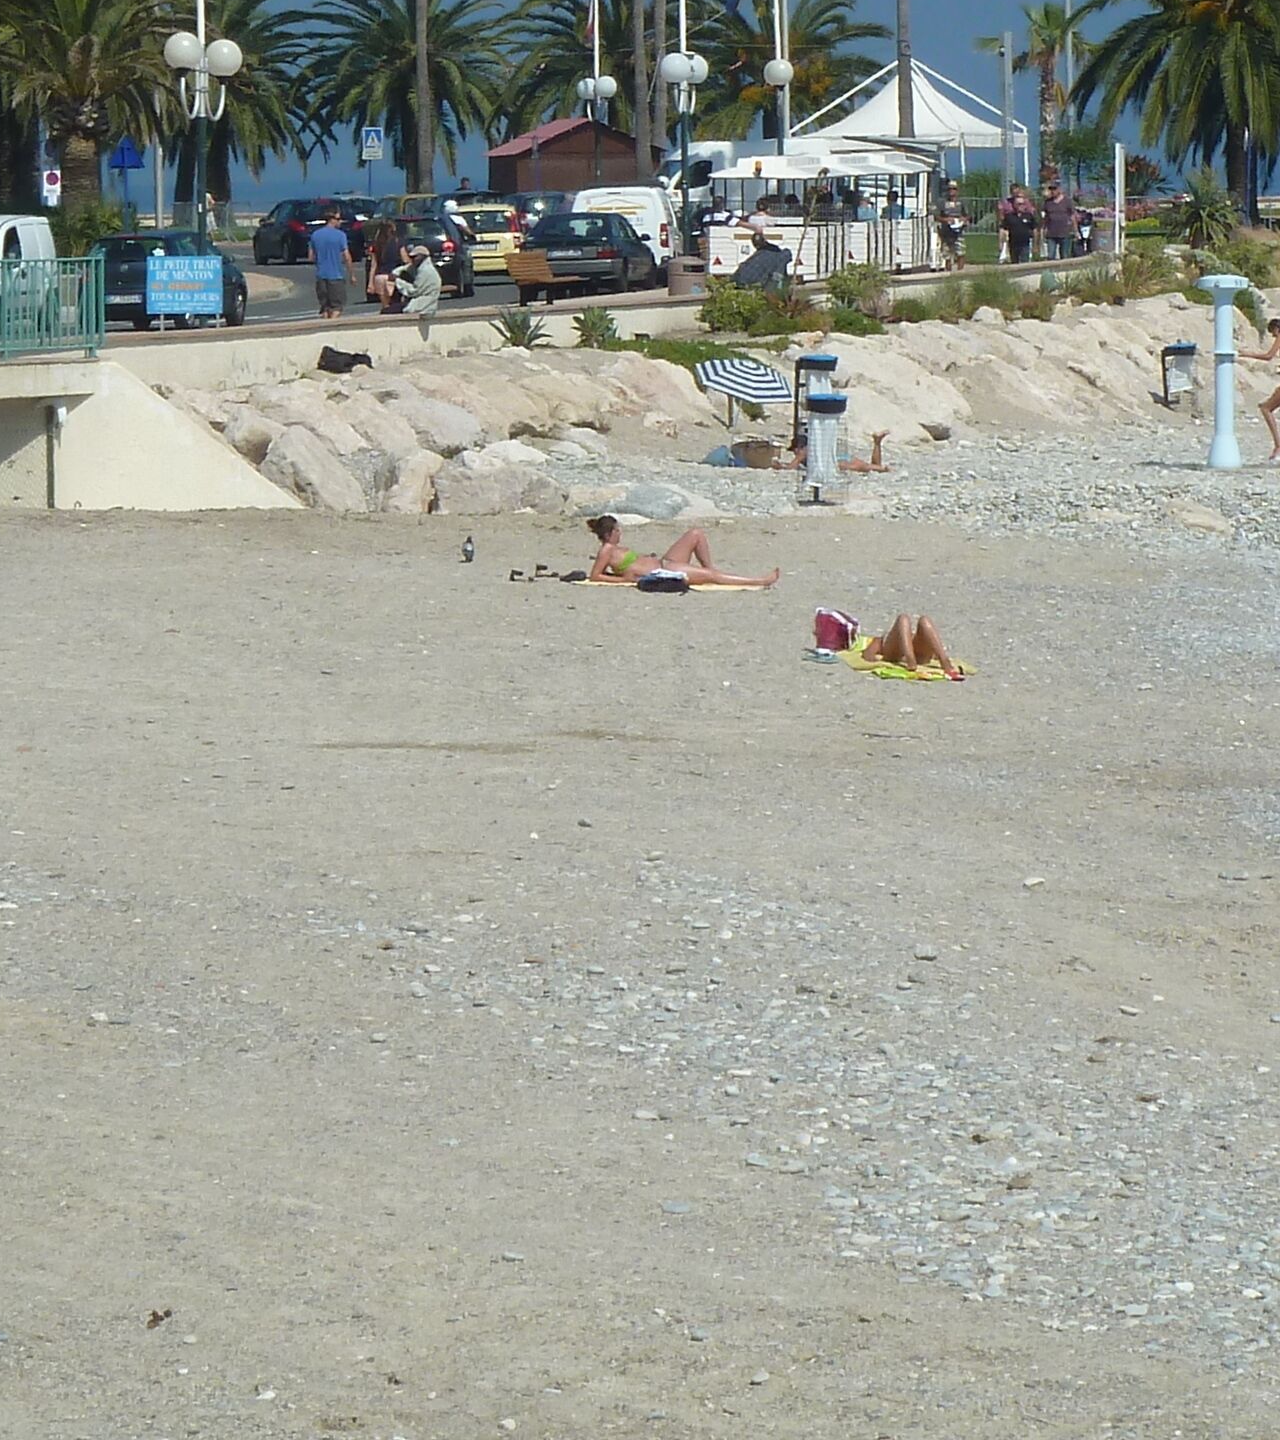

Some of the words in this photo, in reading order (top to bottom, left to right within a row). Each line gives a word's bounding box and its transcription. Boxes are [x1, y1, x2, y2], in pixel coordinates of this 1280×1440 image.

[150, 259, 161, 270] LE
[164, 259, 190, 270] PETIT
[155, 270, 169, 280] DE
[172, 270, 214, 280] MENTON
[151, 292, 173, 301] TOUS
[175, 292, 191, 301] LES
[194, 292, 220, 301] JOURS
